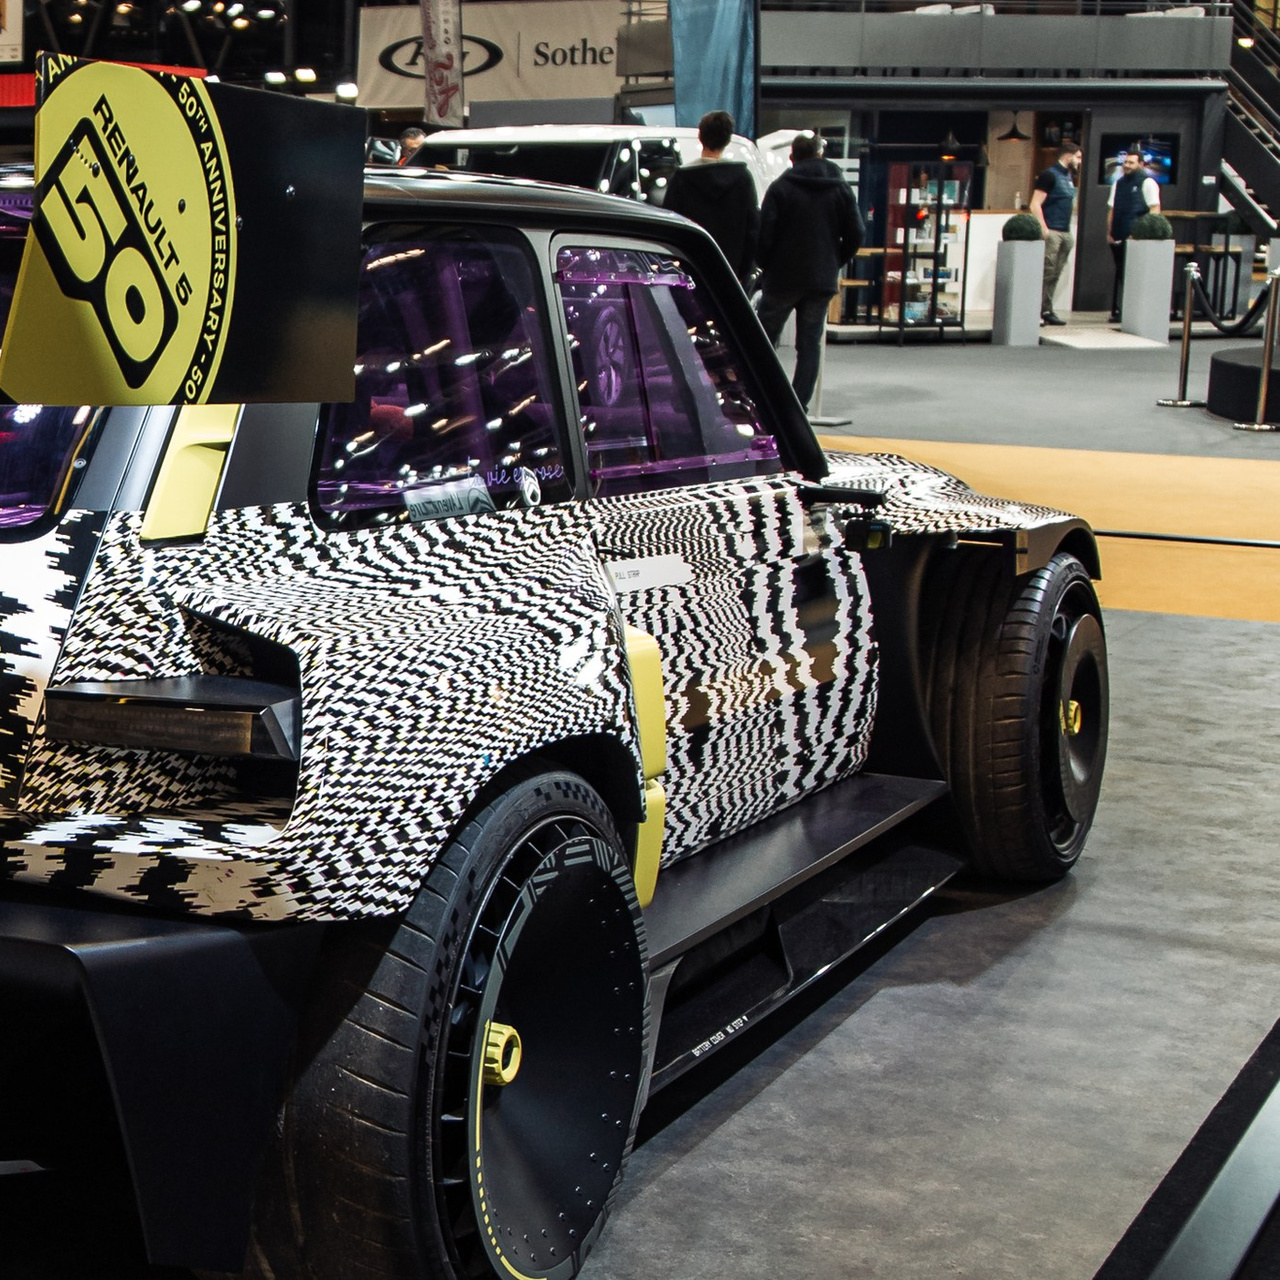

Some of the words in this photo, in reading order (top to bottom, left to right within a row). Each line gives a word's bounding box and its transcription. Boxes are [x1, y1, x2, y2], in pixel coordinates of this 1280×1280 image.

[92, 93, 181, 271] RENAULT
[175, 279, 193, 307] 5
[178, 81, 209, 133] 50TH
[200, 140, 227, 350] ANNIVERSARY
